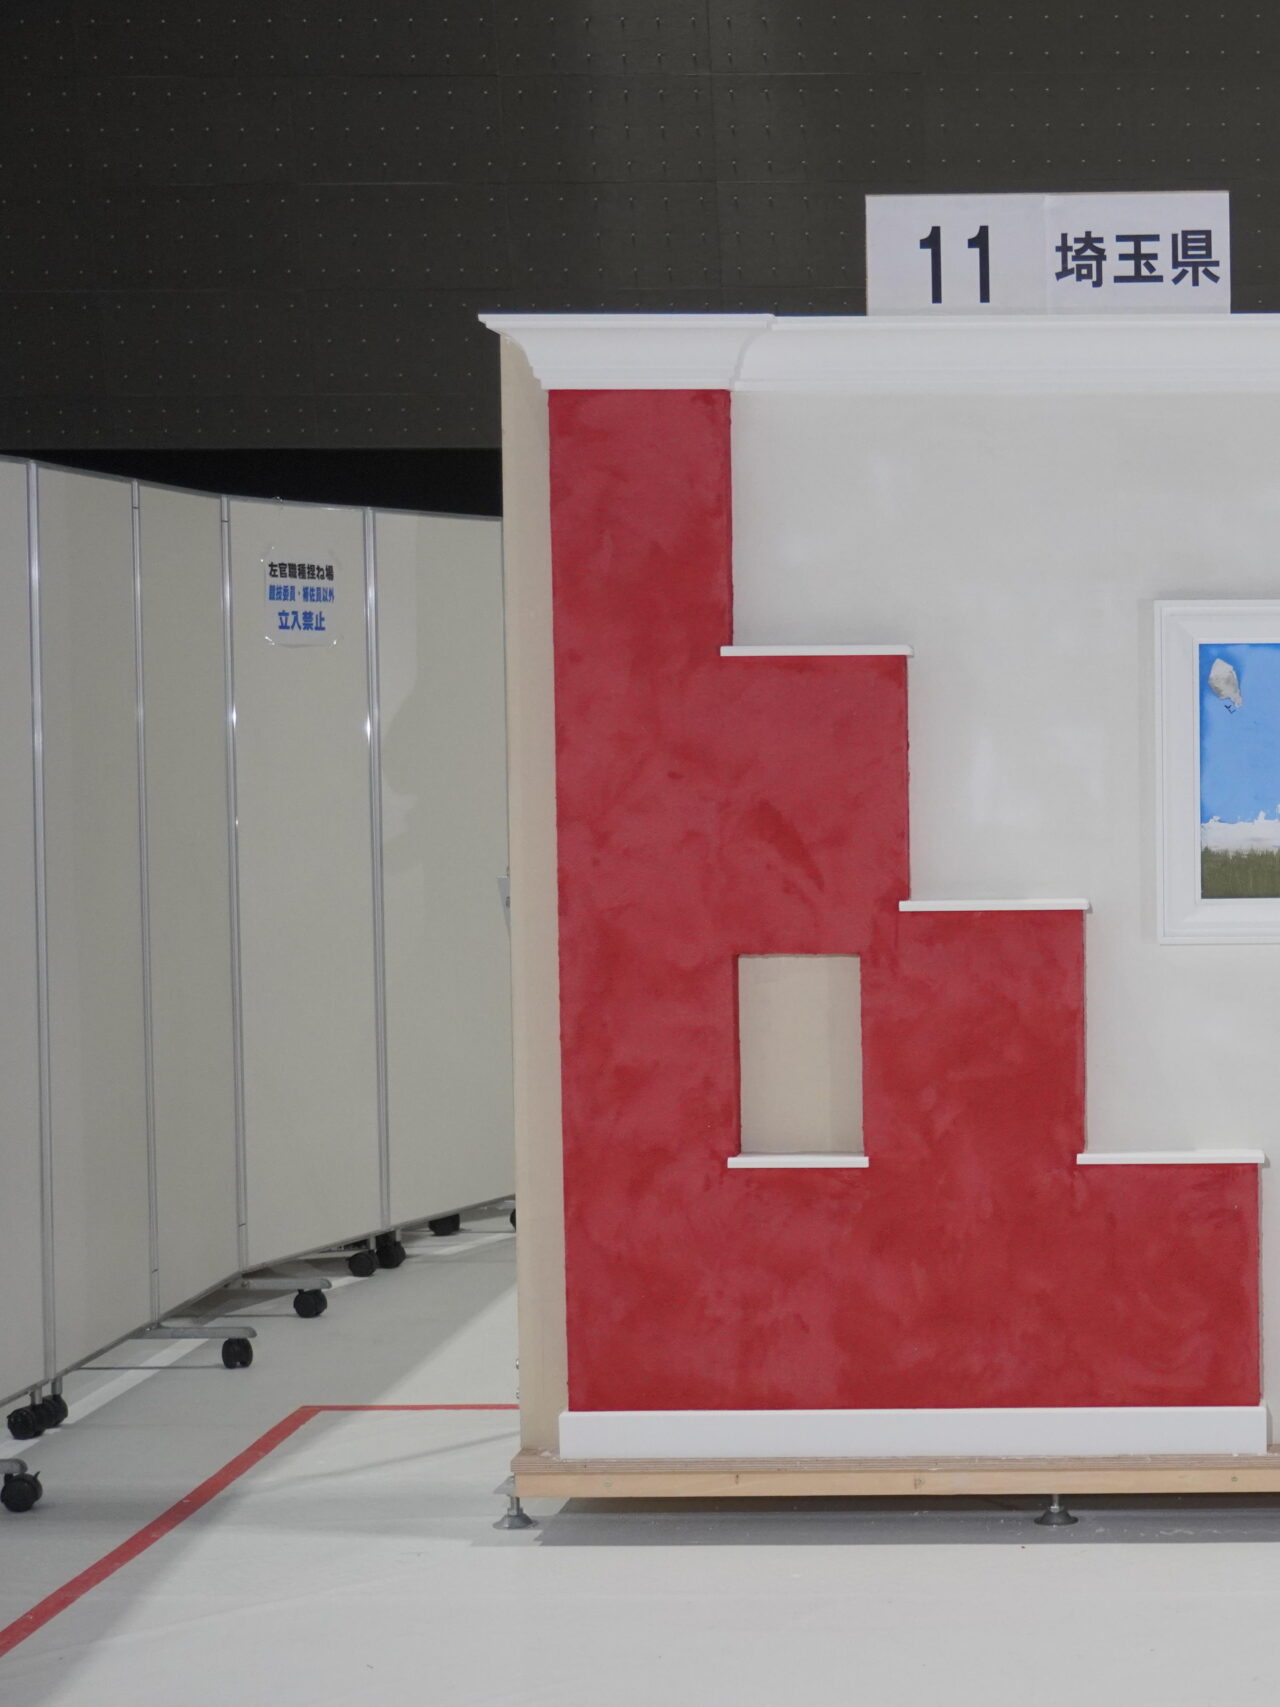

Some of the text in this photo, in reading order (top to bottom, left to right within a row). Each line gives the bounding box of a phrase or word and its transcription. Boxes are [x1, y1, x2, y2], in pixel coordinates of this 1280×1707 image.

[919, 225, 1221, 304] 11 埼玉県
[278, 609, 326, 631] 立入禁止
